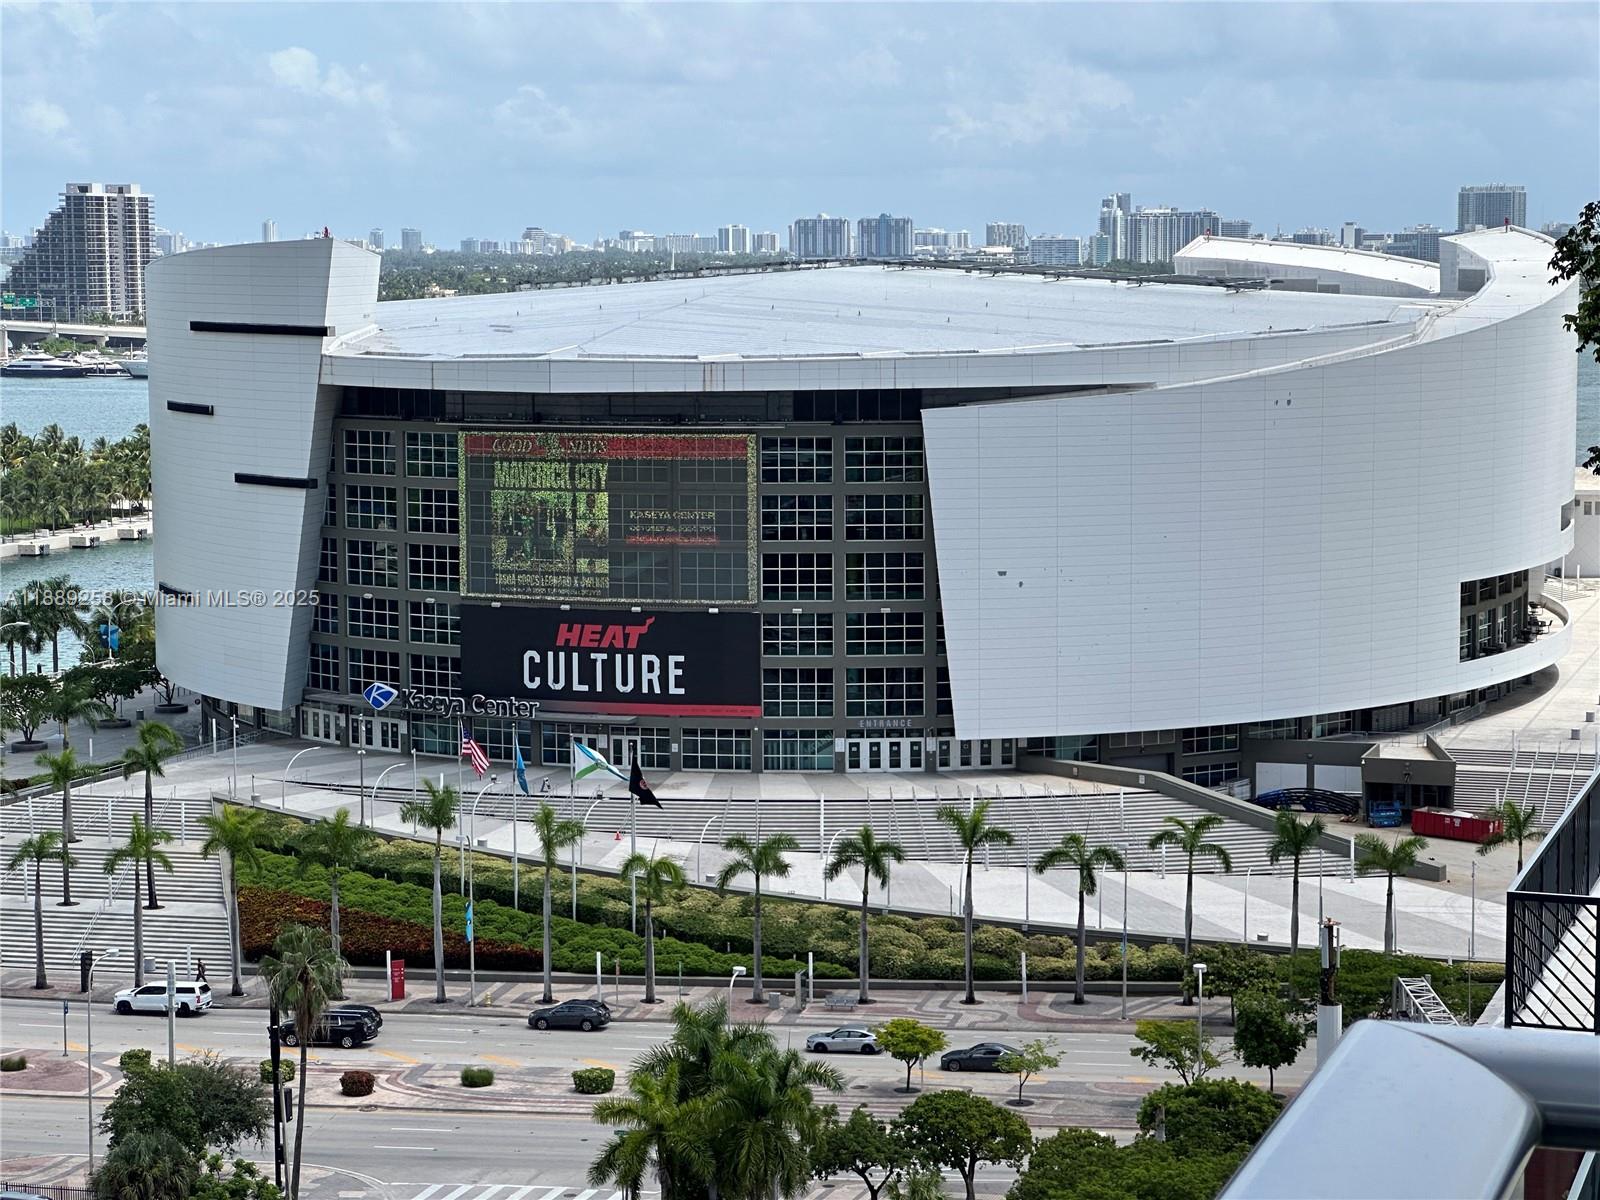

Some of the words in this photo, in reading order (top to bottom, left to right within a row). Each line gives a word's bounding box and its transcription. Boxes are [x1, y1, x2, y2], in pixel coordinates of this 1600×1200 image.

[494, 461, 571, 489] MAVERICK
[575, 462, 609, 490] CITY
[629, 511, 670, 519] KASEYA
[672, 511, 716, 520] CENTER
[555, 616, 655, 649] HEAT
[522, 649, 686, 695] CULTURE
[401, 687, 465, 718] Kaseya
[472, 694, 541, 718] Center
[859, 719, 913, 728] ENTRANCE
